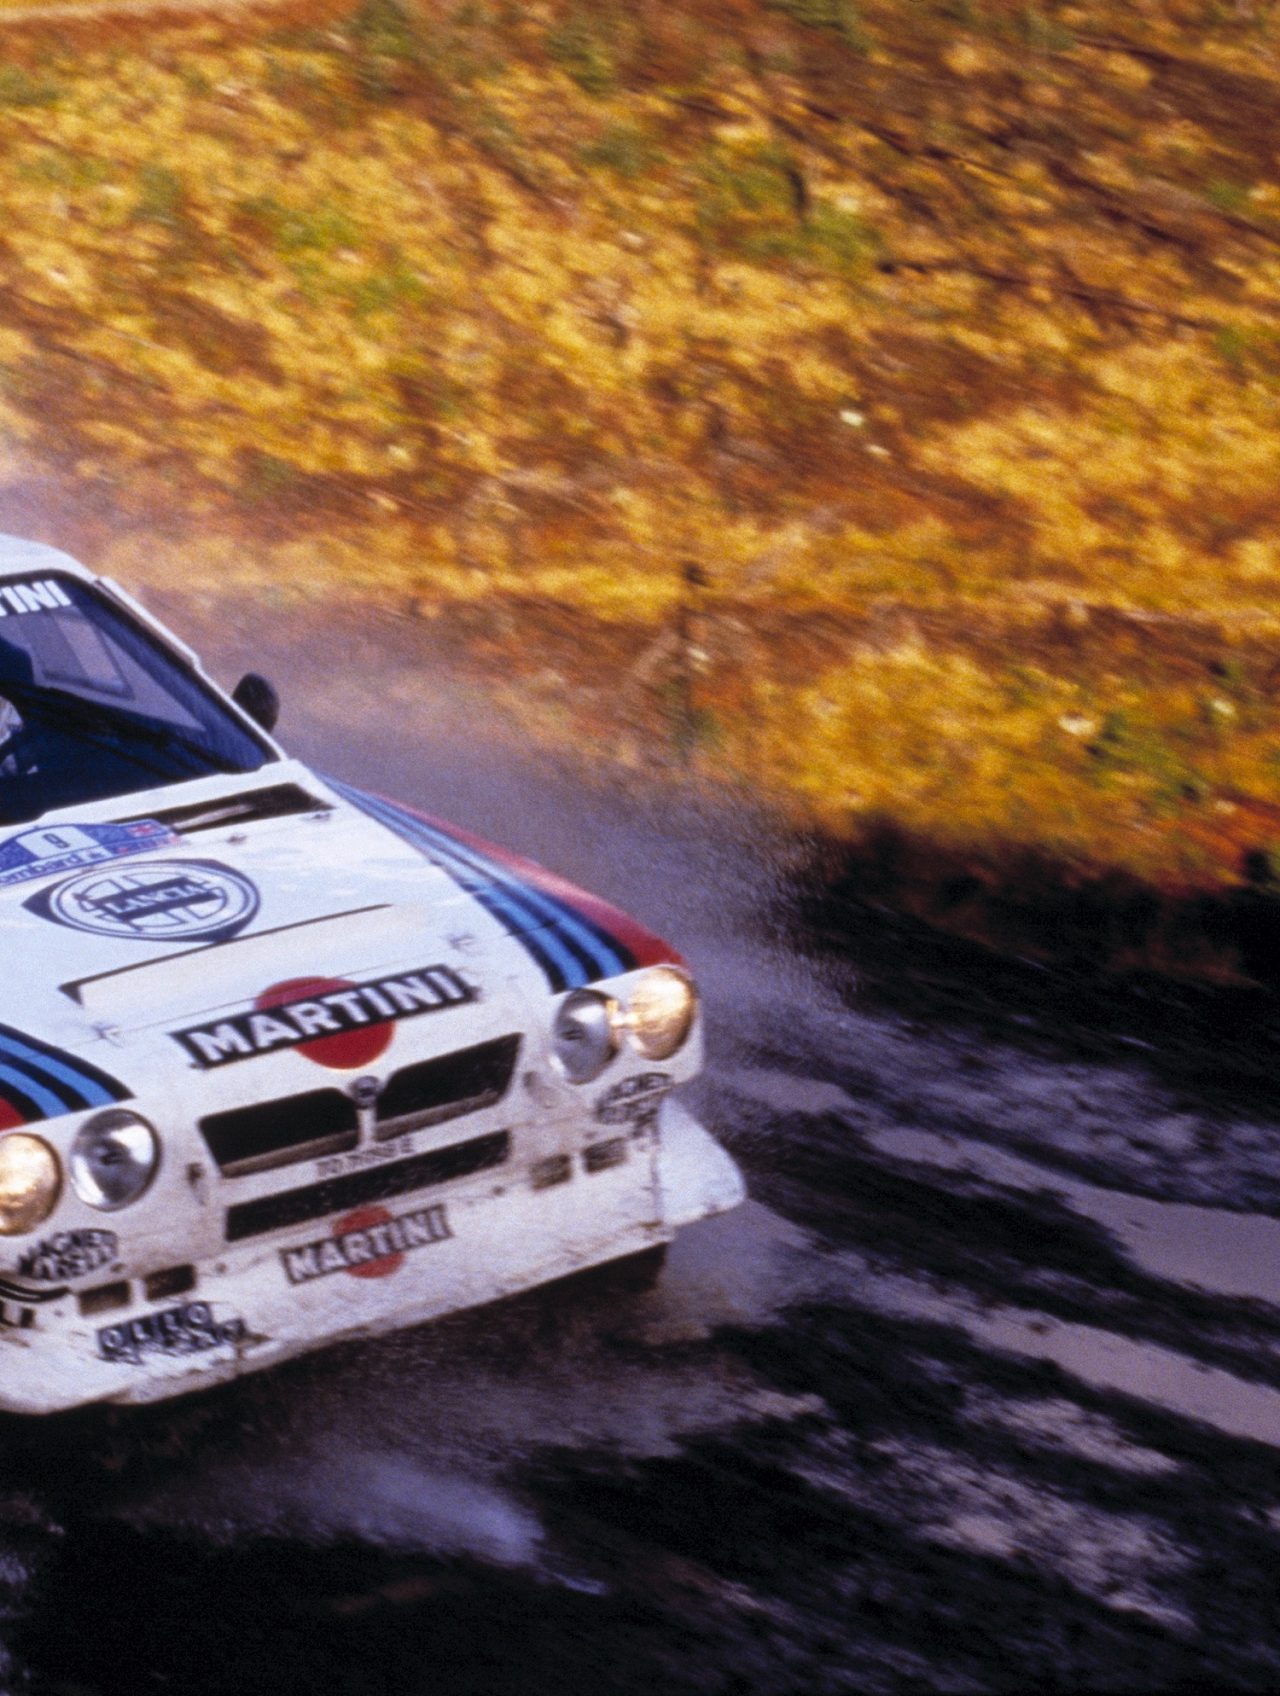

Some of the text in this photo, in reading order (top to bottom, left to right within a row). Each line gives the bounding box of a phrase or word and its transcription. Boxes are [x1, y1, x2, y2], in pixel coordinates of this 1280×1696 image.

[104, 884, 208, 914] LANCIA
[190, 969, 465, 1062] MARTINI
[286, 1208, 447, 1281] MARTINI
